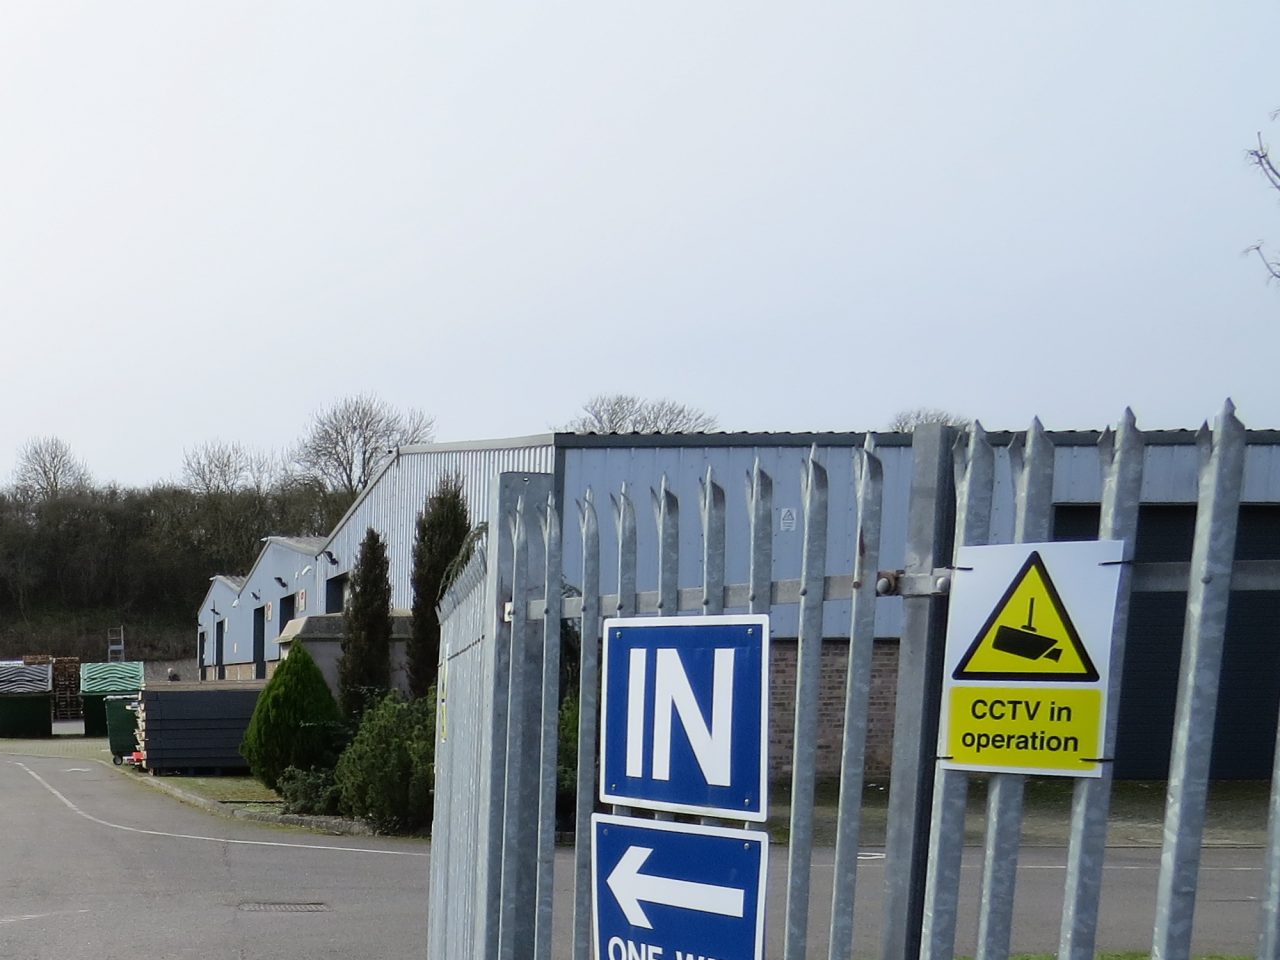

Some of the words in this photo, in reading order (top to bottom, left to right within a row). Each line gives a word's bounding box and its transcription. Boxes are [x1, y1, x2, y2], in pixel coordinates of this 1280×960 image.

[625, 647, 736, 787] IN
[970, 699, 1041, 721] CCTV
[1049, 700, 1072, 722] in
[961, 730, 1079, 753] operation
